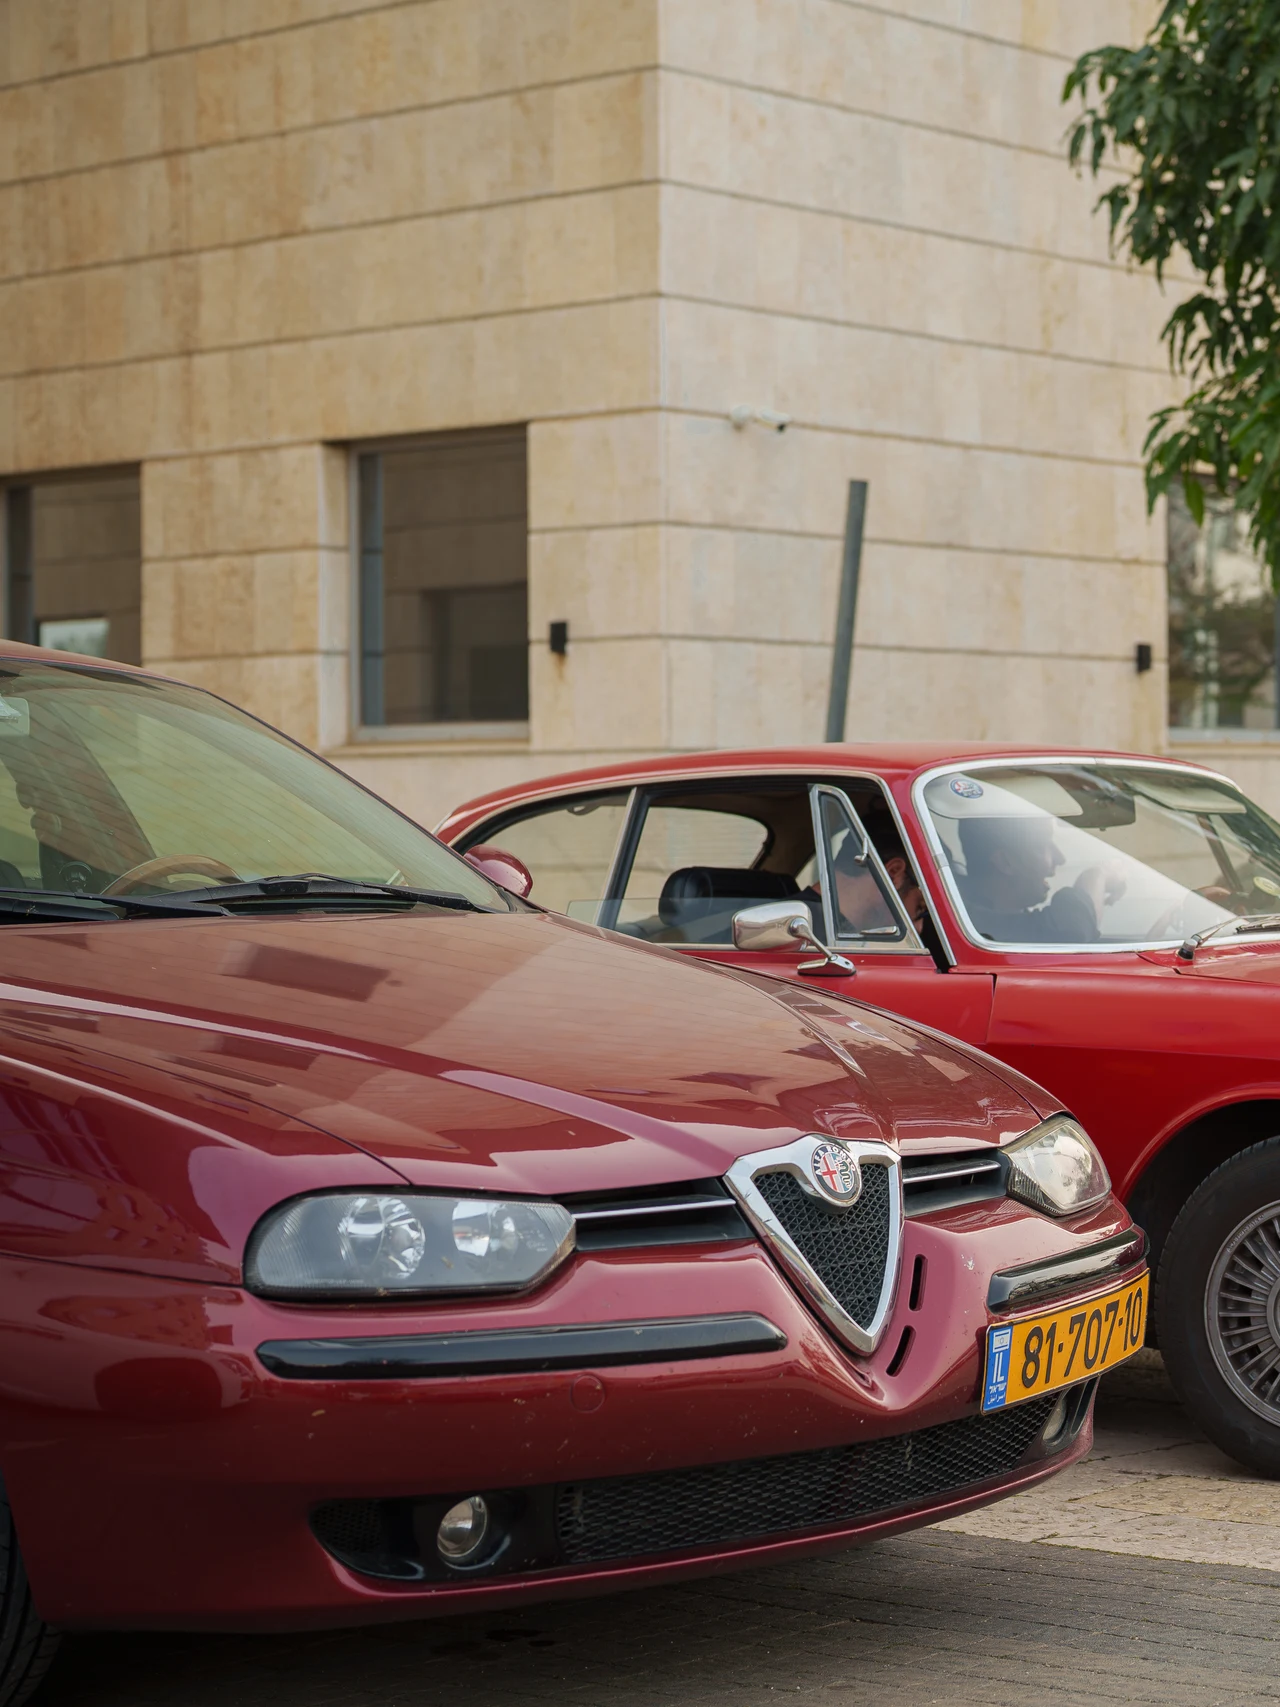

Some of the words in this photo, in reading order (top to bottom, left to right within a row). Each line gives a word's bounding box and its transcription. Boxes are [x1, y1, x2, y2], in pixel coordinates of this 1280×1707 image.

[813, 1149, 824, 1175] ALFA
[826, 1145, 856, 1171] ROMEO
[993, 1352, 1005, 1383] IL
